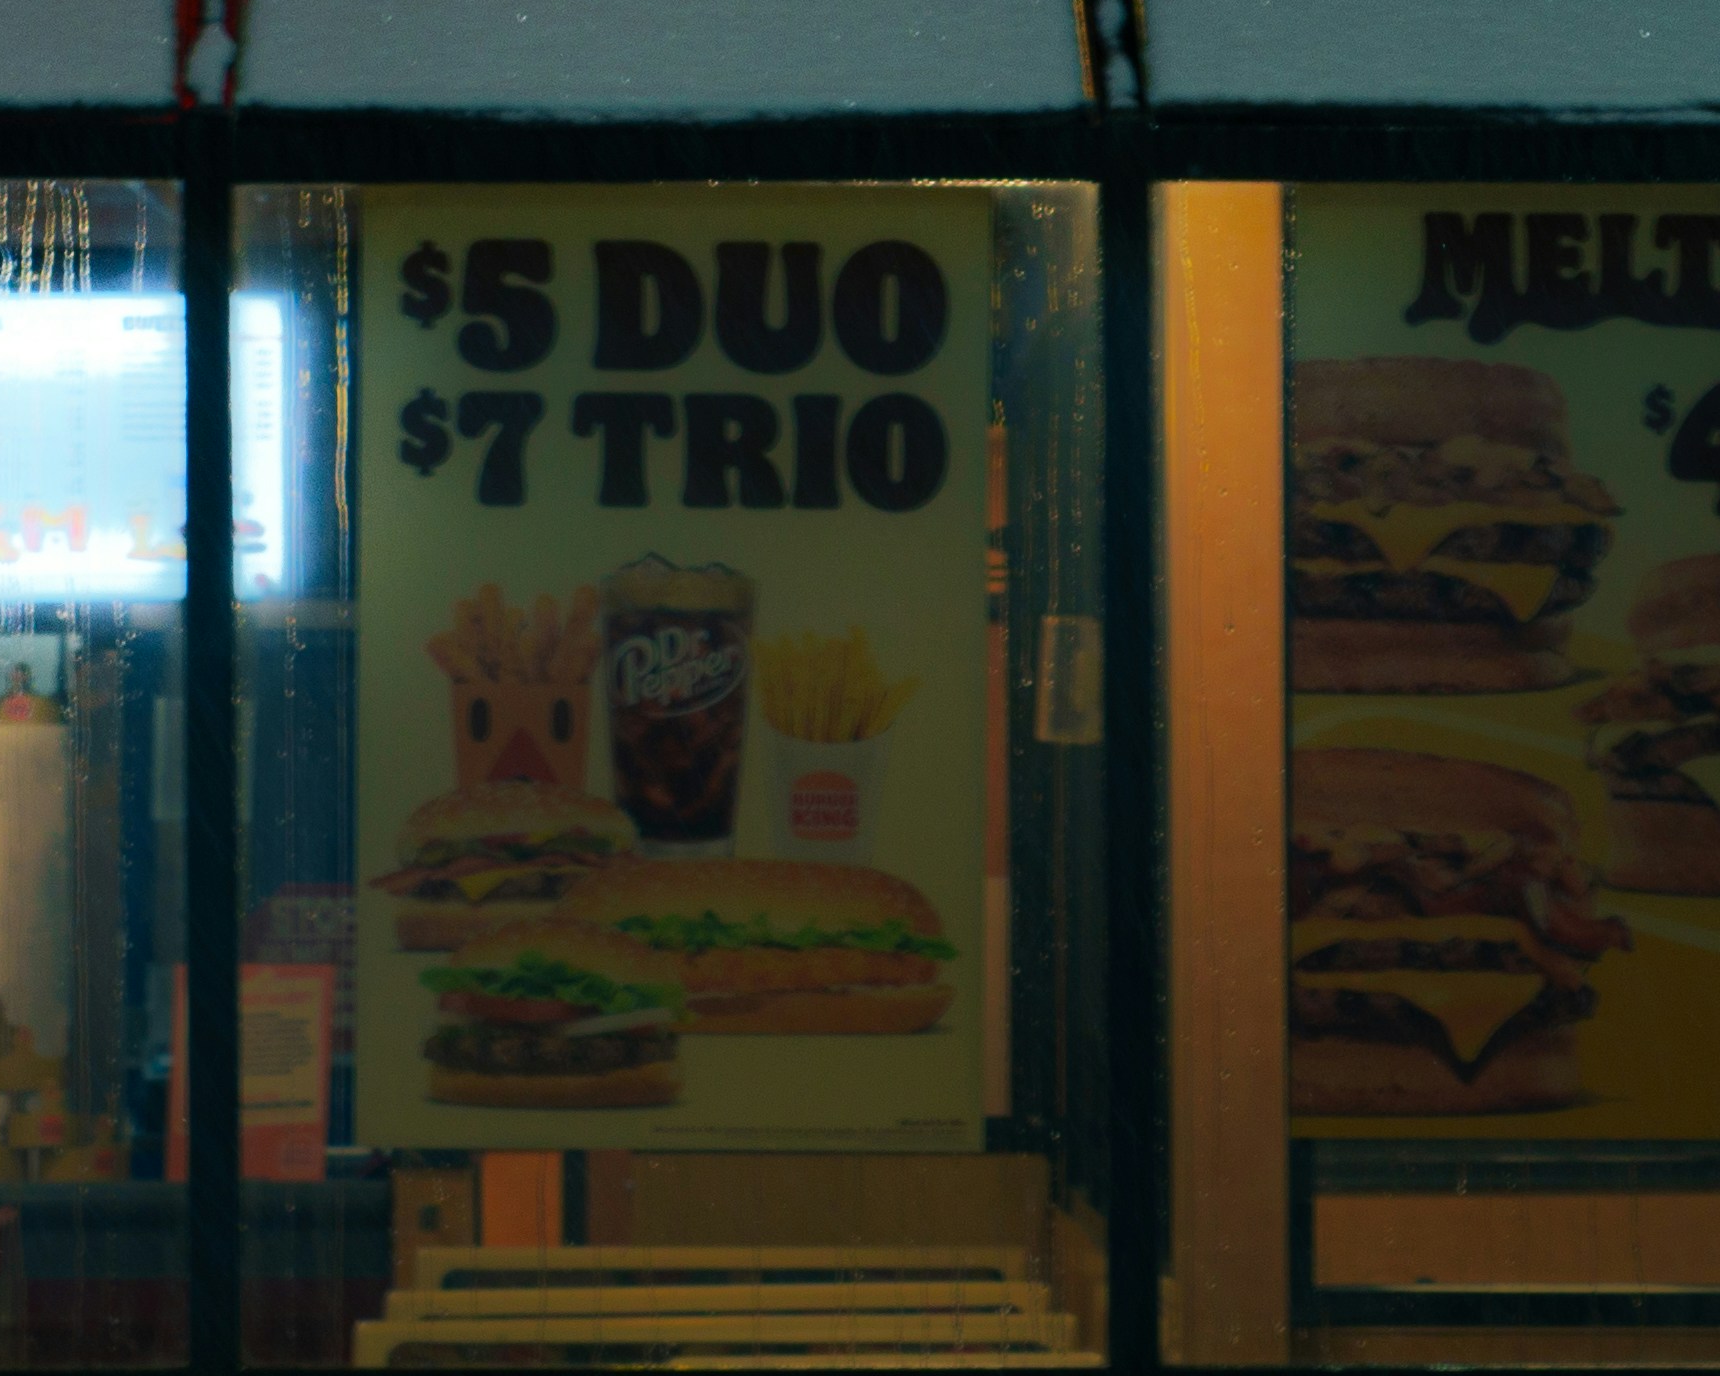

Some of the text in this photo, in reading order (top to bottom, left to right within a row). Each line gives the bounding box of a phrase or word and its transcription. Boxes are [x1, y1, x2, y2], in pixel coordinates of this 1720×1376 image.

[400, 237, 949, 375] $5 DUO
[400, 387, 548, 508] $7
[572, 391, 949, 513] TRIO
[614, 634, 743, 706] Pepper
